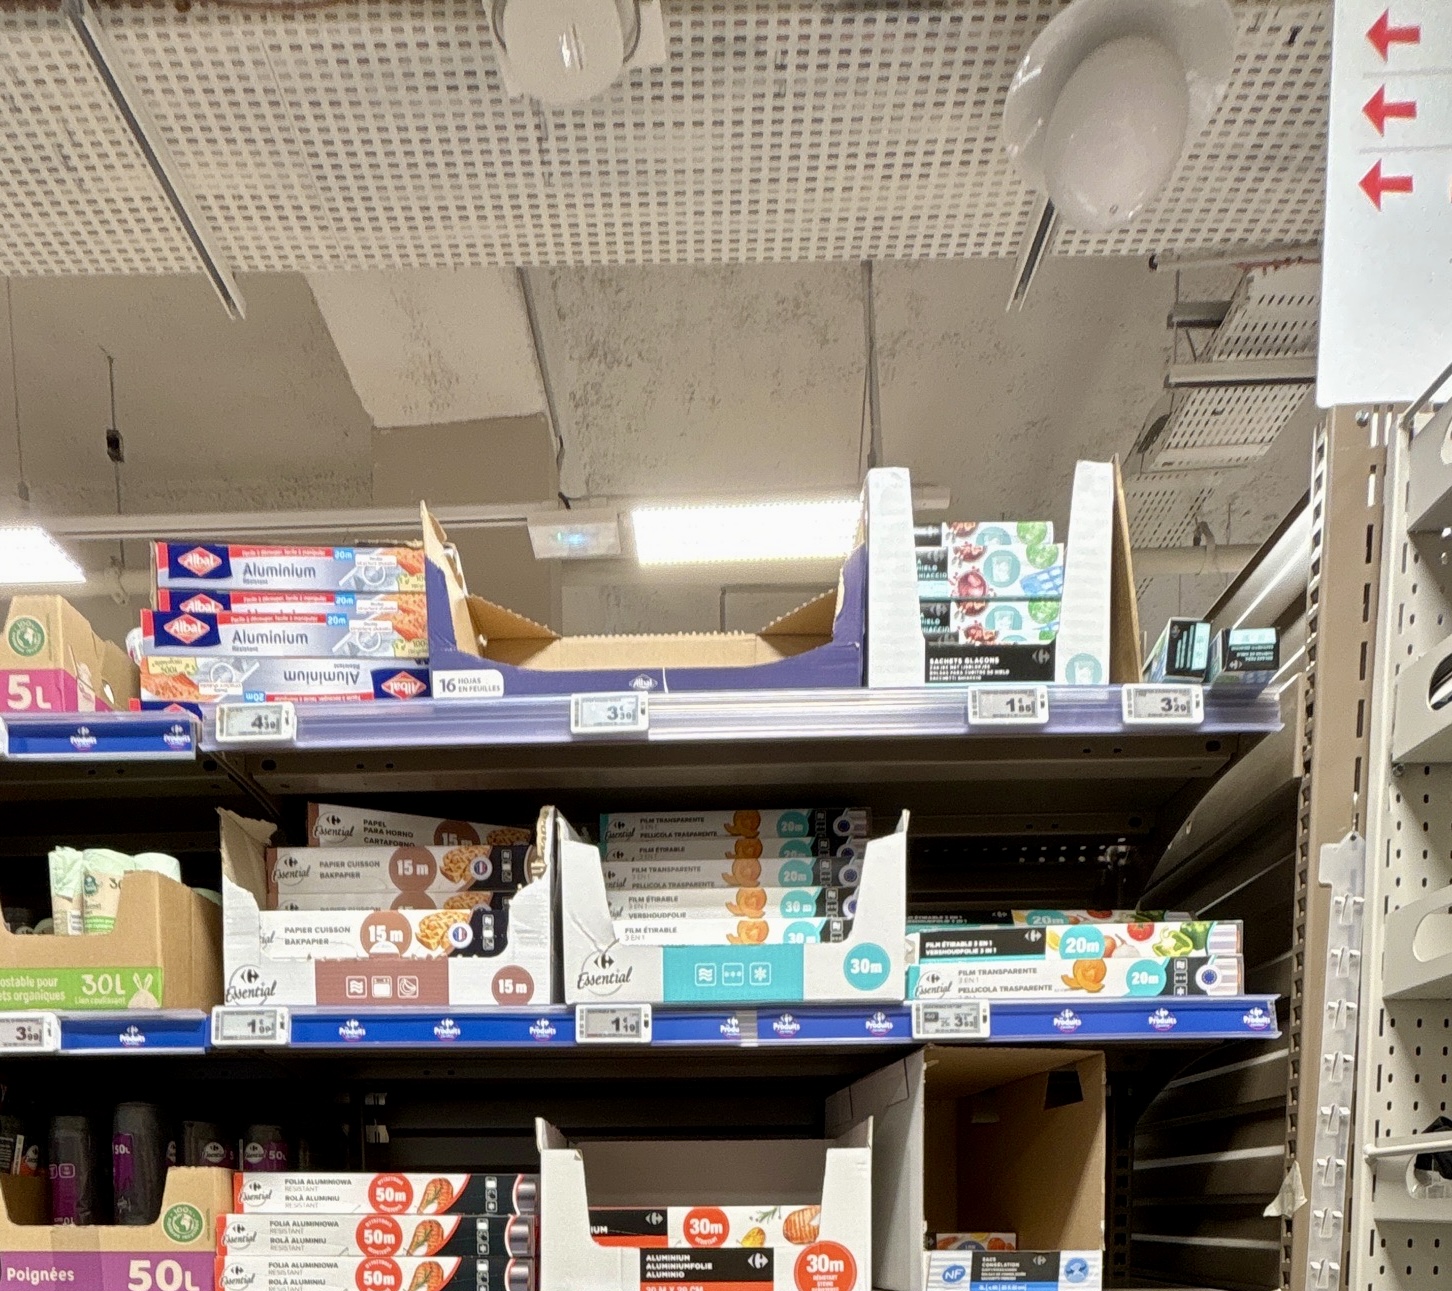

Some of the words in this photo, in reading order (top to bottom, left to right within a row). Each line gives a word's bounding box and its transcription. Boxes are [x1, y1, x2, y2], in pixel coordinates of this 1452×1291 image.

[186, 552, 214, 567] Albal
[242, 562, 316, 578] Aluminium
[170, 620, 201, 634] Albal
[232, 629, 309, 645] Aluminium
[283, 669, 360, 686] Aluminium
[457, 677, 482, 685] HOJAS
[389, 679, 420, 695] Albal
[439, 678, 456, 693] 16
[469, 684, 501, 693] FEUILLES
[363, 819, 387, 828] PAPEL
[657, 816, 705, 824] TRANSPARENTE
[781, 820, 803, 832] 20m
[363, 827, 384, 836] PARA
[385, 829, 414, 839] HORNO
[640, 831, 674, 839] PELLICOLA
[675, 830, 718, 838] TRASPARENTE
[319, 860, 346, 868] PAPIER
[348, 860, 381, 868] CUISSON
[631, 866, 647, 874] FILM
[649, 865, 701, 874] TRANSPARENTE
[272, 863, 312, 882] Essential
[319, 871, 361, 879] BAKPAPIER
[783, 870, 807, 882] 20m
[631, 881, 668, 889] PELLICOLA
[669, 880, 715, 888] TRASPARENTE
[628, 895, 646, 903] FILM
[284, 926, 312, 935] PAPIER
[314, 926, 351, 935] CUISSON
[625, 926, 642, 935] FILM
[644, 925, 678, 935] ÉTIRABLE
[284, 937, 330, 946] BAKPAPIER
[1065, 937, 1100, 954] 20m
[850, 959, 883, 975] 30m
[978, 968, 1038, 976] TRANSPARENTE
[577, 966, 633, 989] Essential
[1131, 972, 1160, 985] 20m
[37, 979, 58, 992] pour
[81, 973, 126, 995] 30L
[958, 986, 998, 994] PELLICOLA
[1000, 984, 1054, 993] TRASPARENTE
[225, 979, 278, 1002] Essential
[14, 991, 66, 1004] organiques
[306, 1178, 352, 1186] ALUMINIOWA
[375, 1187, 407, 1203] 50m
[269, 1220, 289, 1228] FOLIA
[291, 1220, 340, 1228] ALUMINIOWA
[689, 1218, 723, 1235] 30m
[363, 1229, 396, 1246] 50m
[290, 1261, 339, 1269] ALUMINIOWA
[806, 1254, 845, 1273] 30m
[6, 1266, 75, 1285] Poignées
[363, 1270, 396, 1286] 50m
[645, 1271, 685, 1279] ALUMINIO
[944, 1269, 963, 1280] NF
